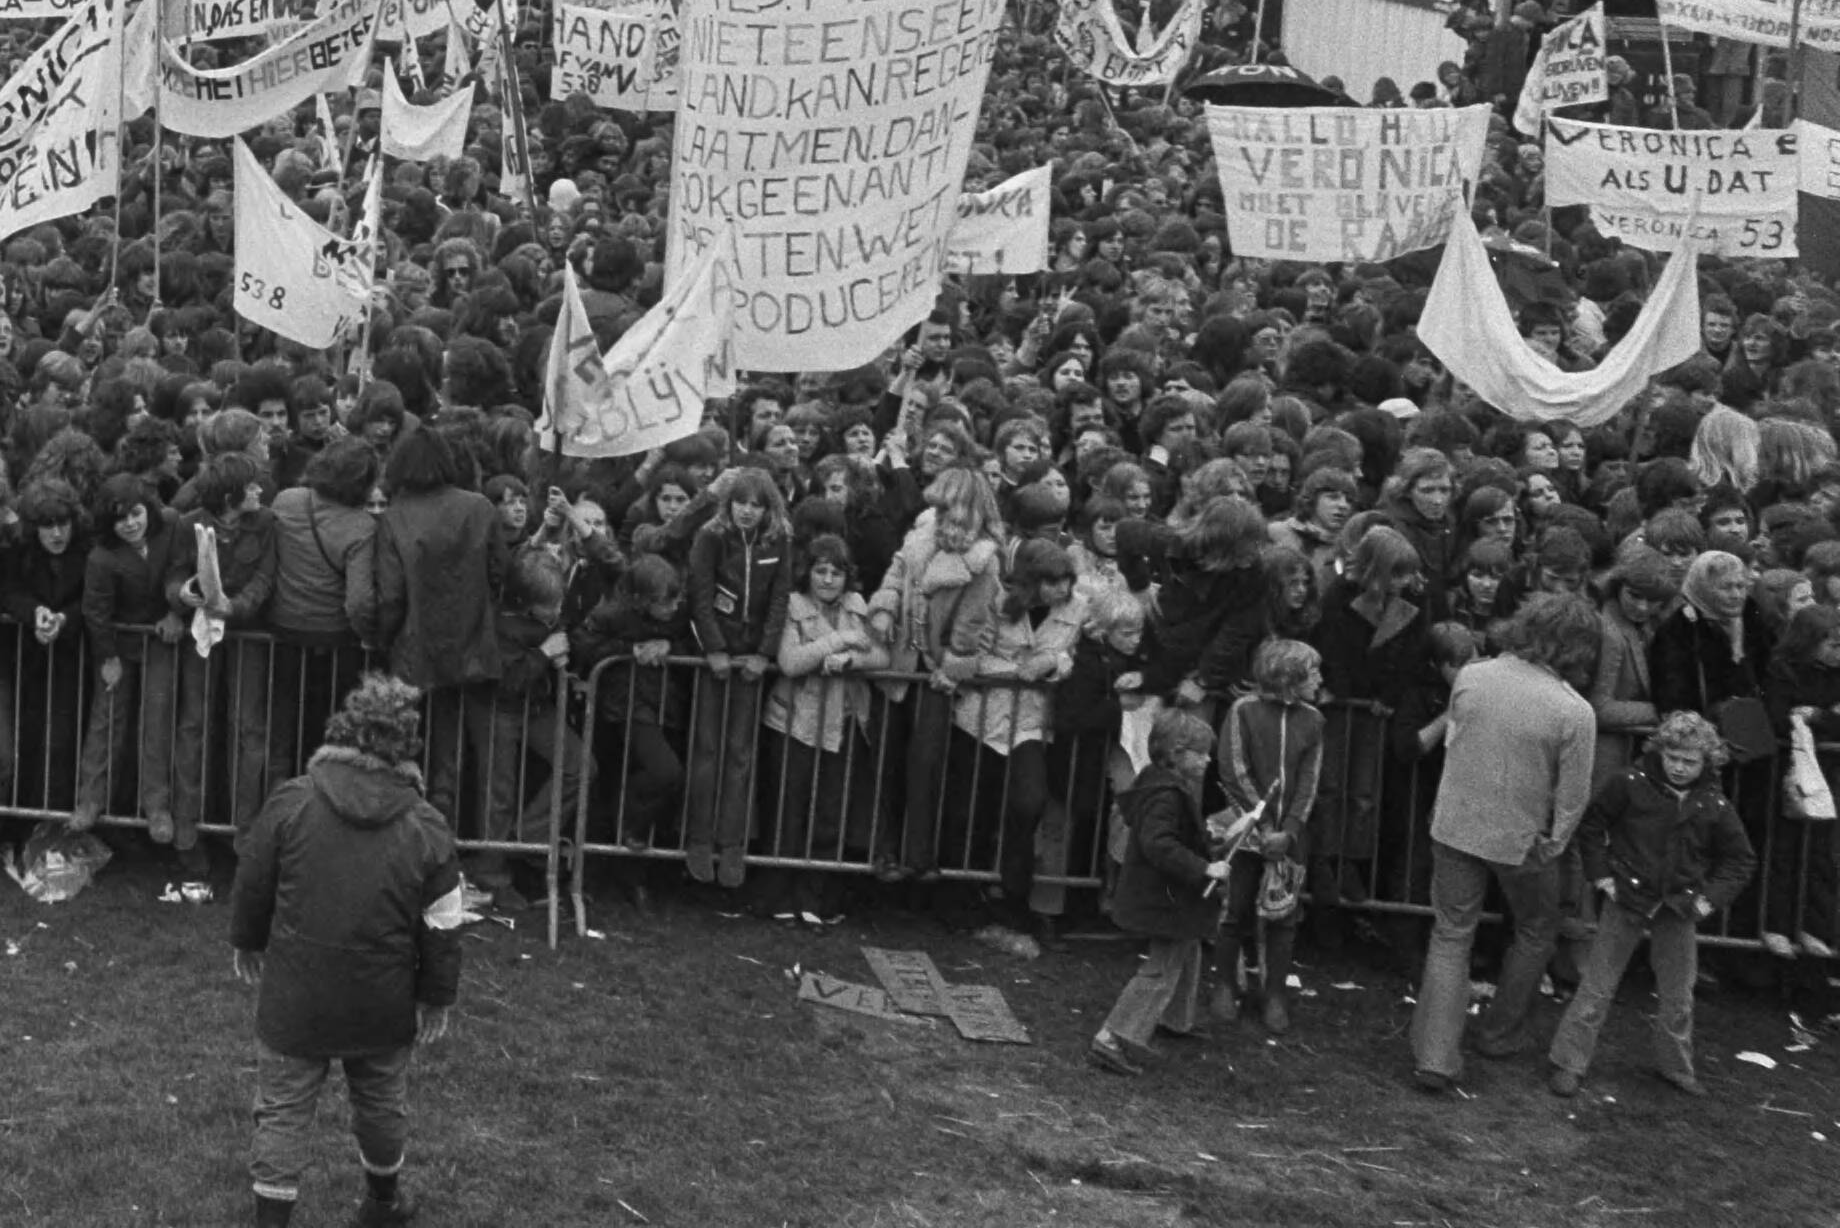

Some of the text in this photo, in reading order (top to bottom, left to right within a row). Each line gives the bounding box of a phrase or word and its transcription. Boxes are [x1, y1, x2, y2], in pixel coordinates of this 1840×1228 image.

[1549, 118, 1753, 159] VERONICA
[1238, 144, 1461, 190] VERONICA
[1601, 168, 1650, 191] ALS
[239, 271, 287, 311] 538
